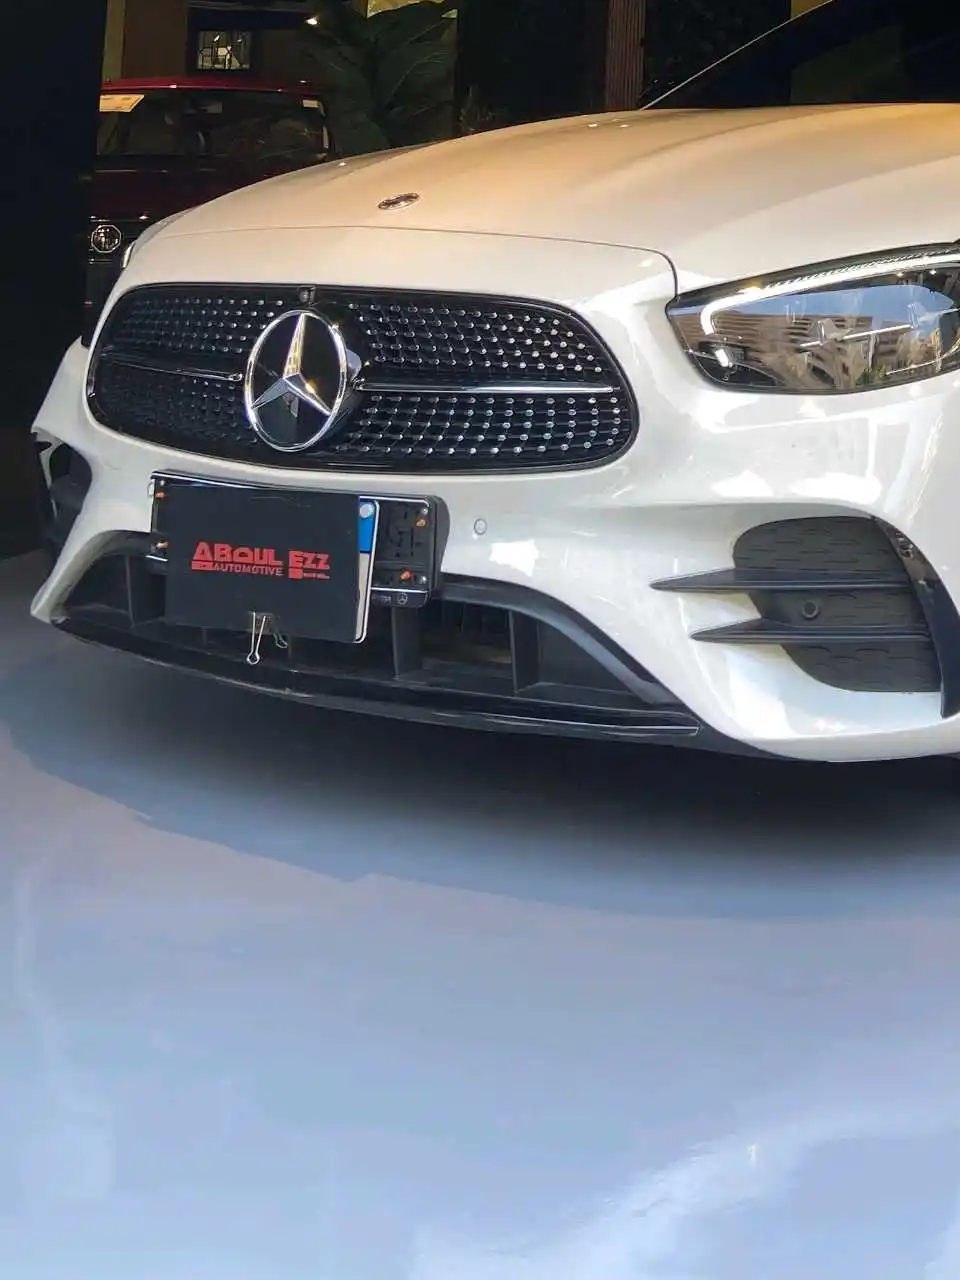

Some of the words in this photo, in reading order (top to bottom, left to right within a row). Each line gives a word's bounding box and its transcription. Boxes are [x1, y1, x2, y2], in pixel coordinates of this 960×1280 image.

[192, 541, 284, 567] ABOUL
[288, 550, 331, 570] EZZ
[213, 563, 285, 577] AUTOMOTIVE
